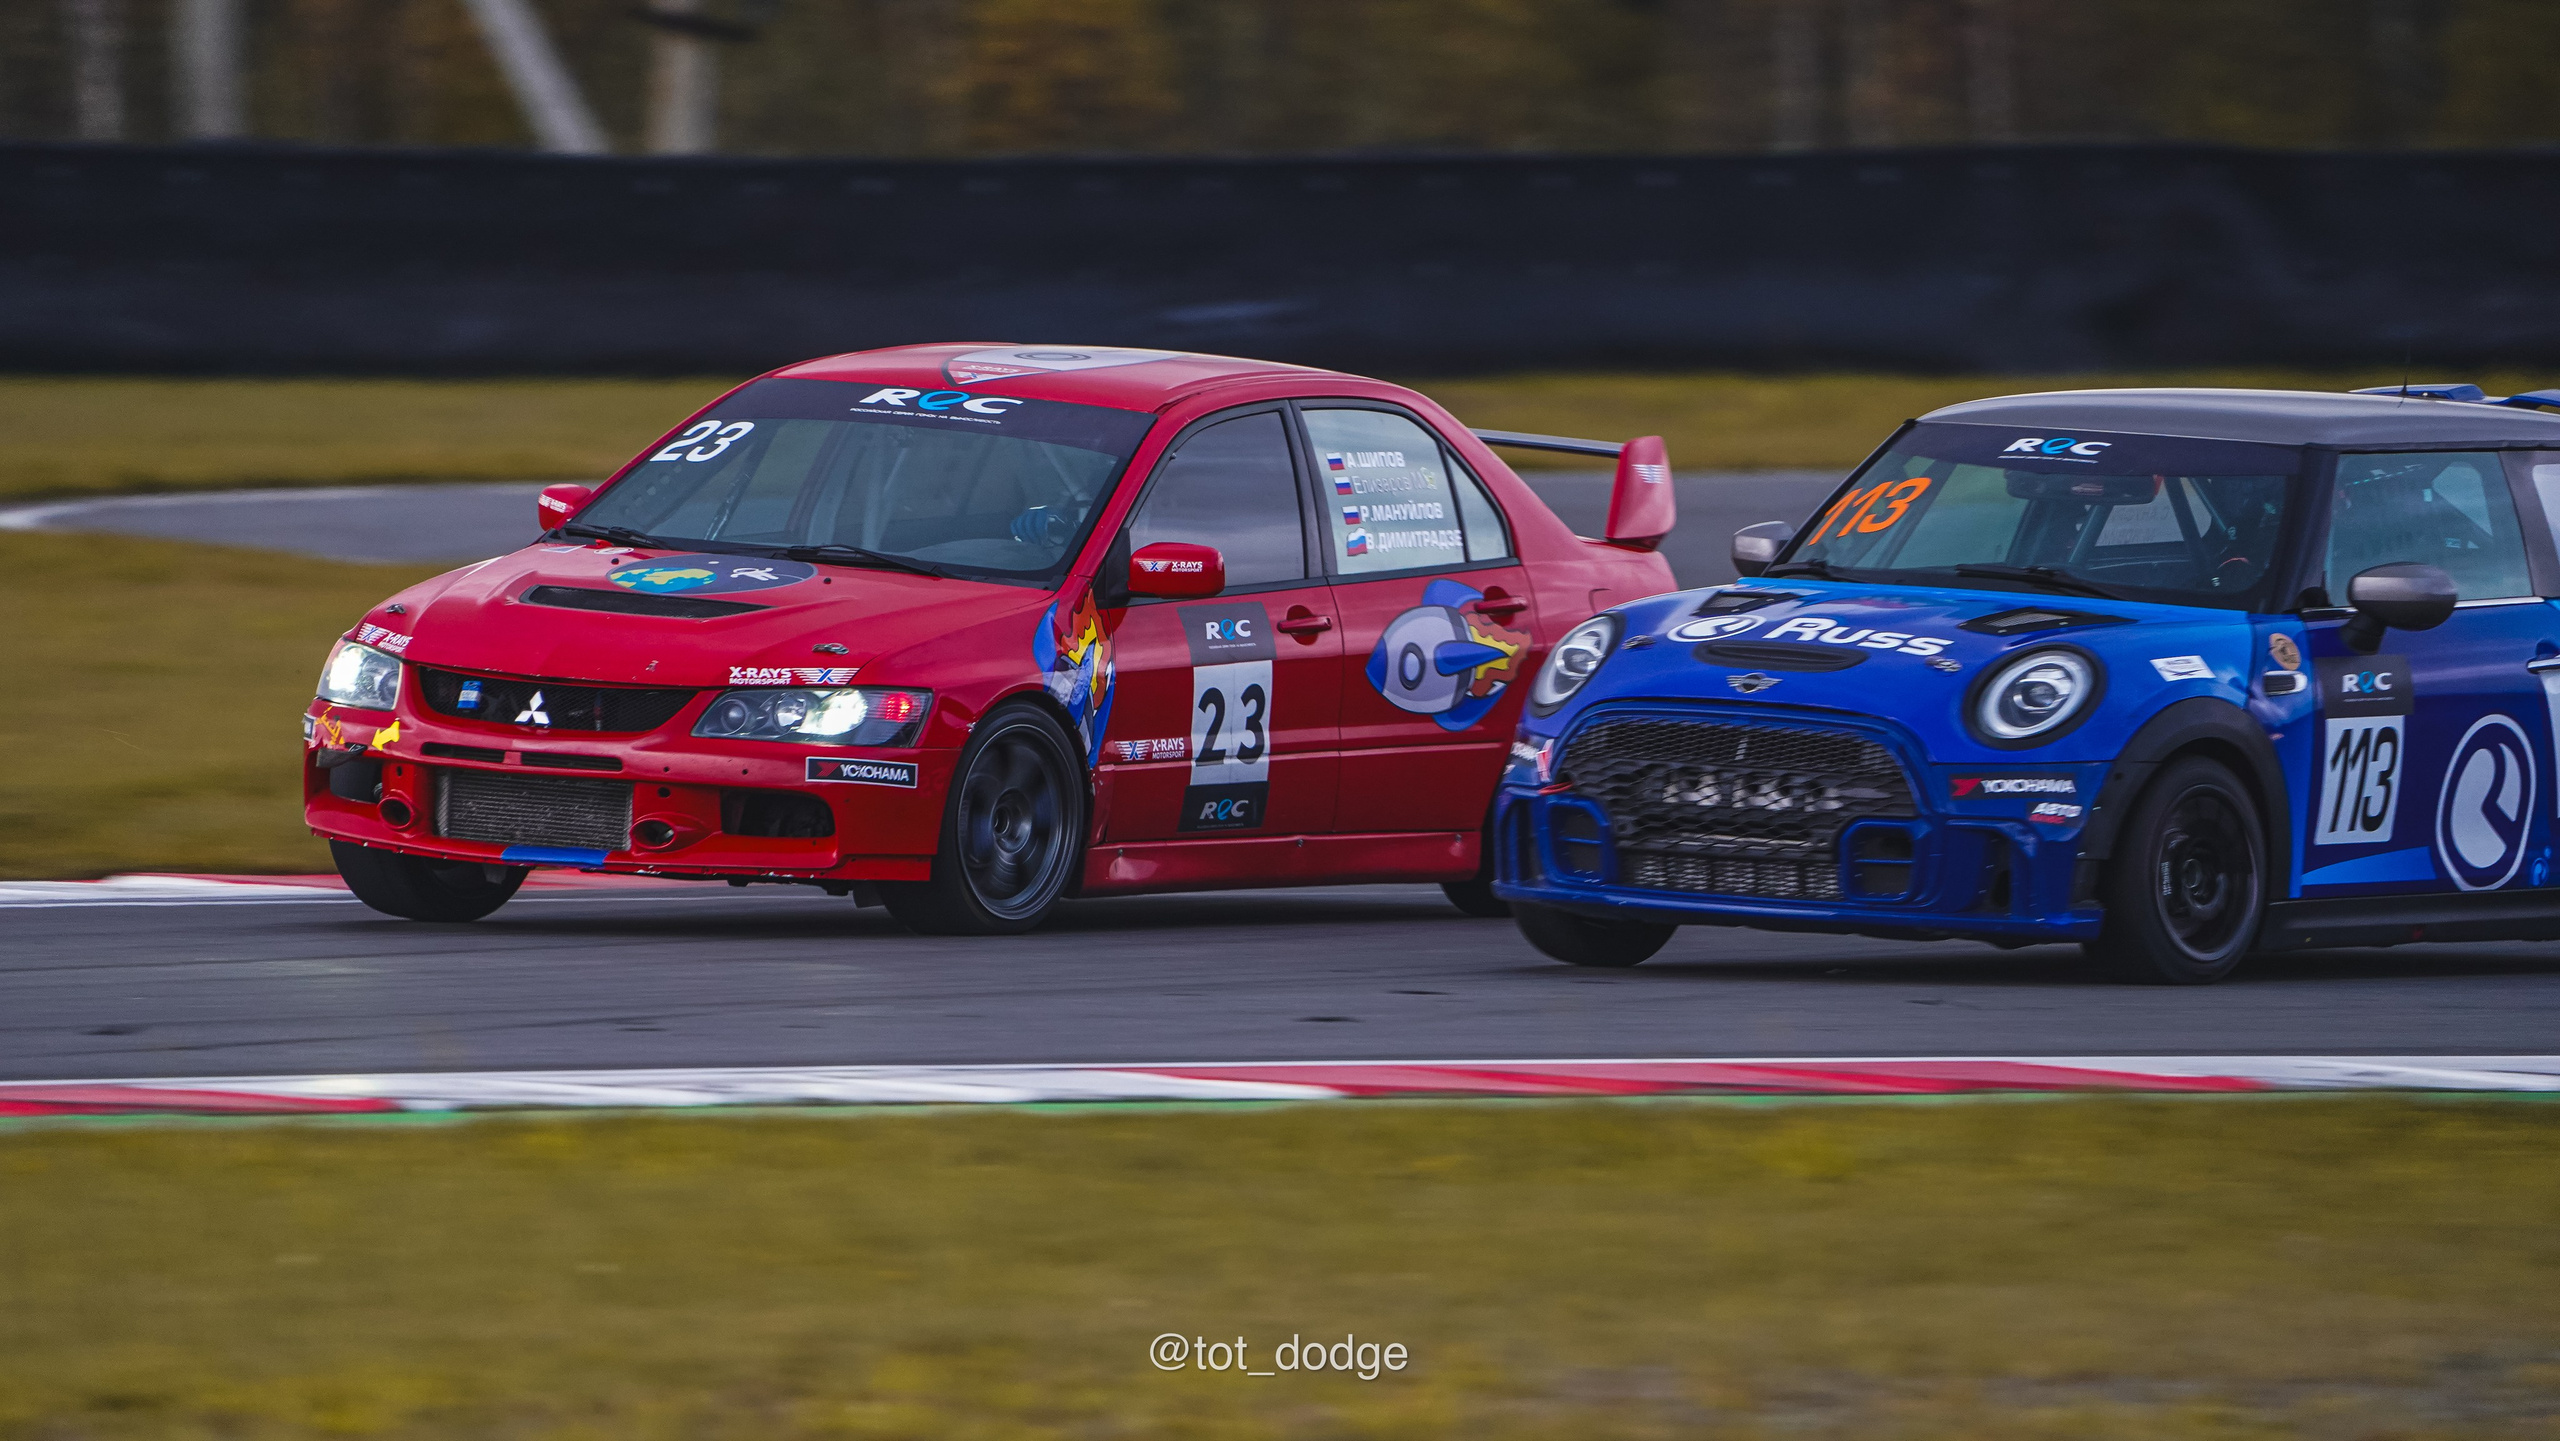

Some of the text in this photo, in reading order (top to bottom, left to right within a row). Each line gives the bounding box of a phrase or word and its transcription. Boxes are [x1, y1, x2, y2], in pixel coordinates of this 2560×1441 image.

[649, 420, 755, 463] 23
[1346, 451, 1406, 468] А.ШИПОВ
[1360, 500, 1444, 522] Р.МАНУЙЛОВ
[1807, 477, 1932, 546] 113
[1366, 529, 1463, 553] В.ДИМИТРАДЗЕ
[729, 677, 792, 685] MOTORSPORT
[1195, 683, 1266, 767] 23
[1152, 750, 1185, 760] MOTORSPORT
[840, 764, 909, 782] YOKOHAMA
[2327, 726, 2399, 833] 113
[1981, 779, 2076, 794] YOKOHAMA
